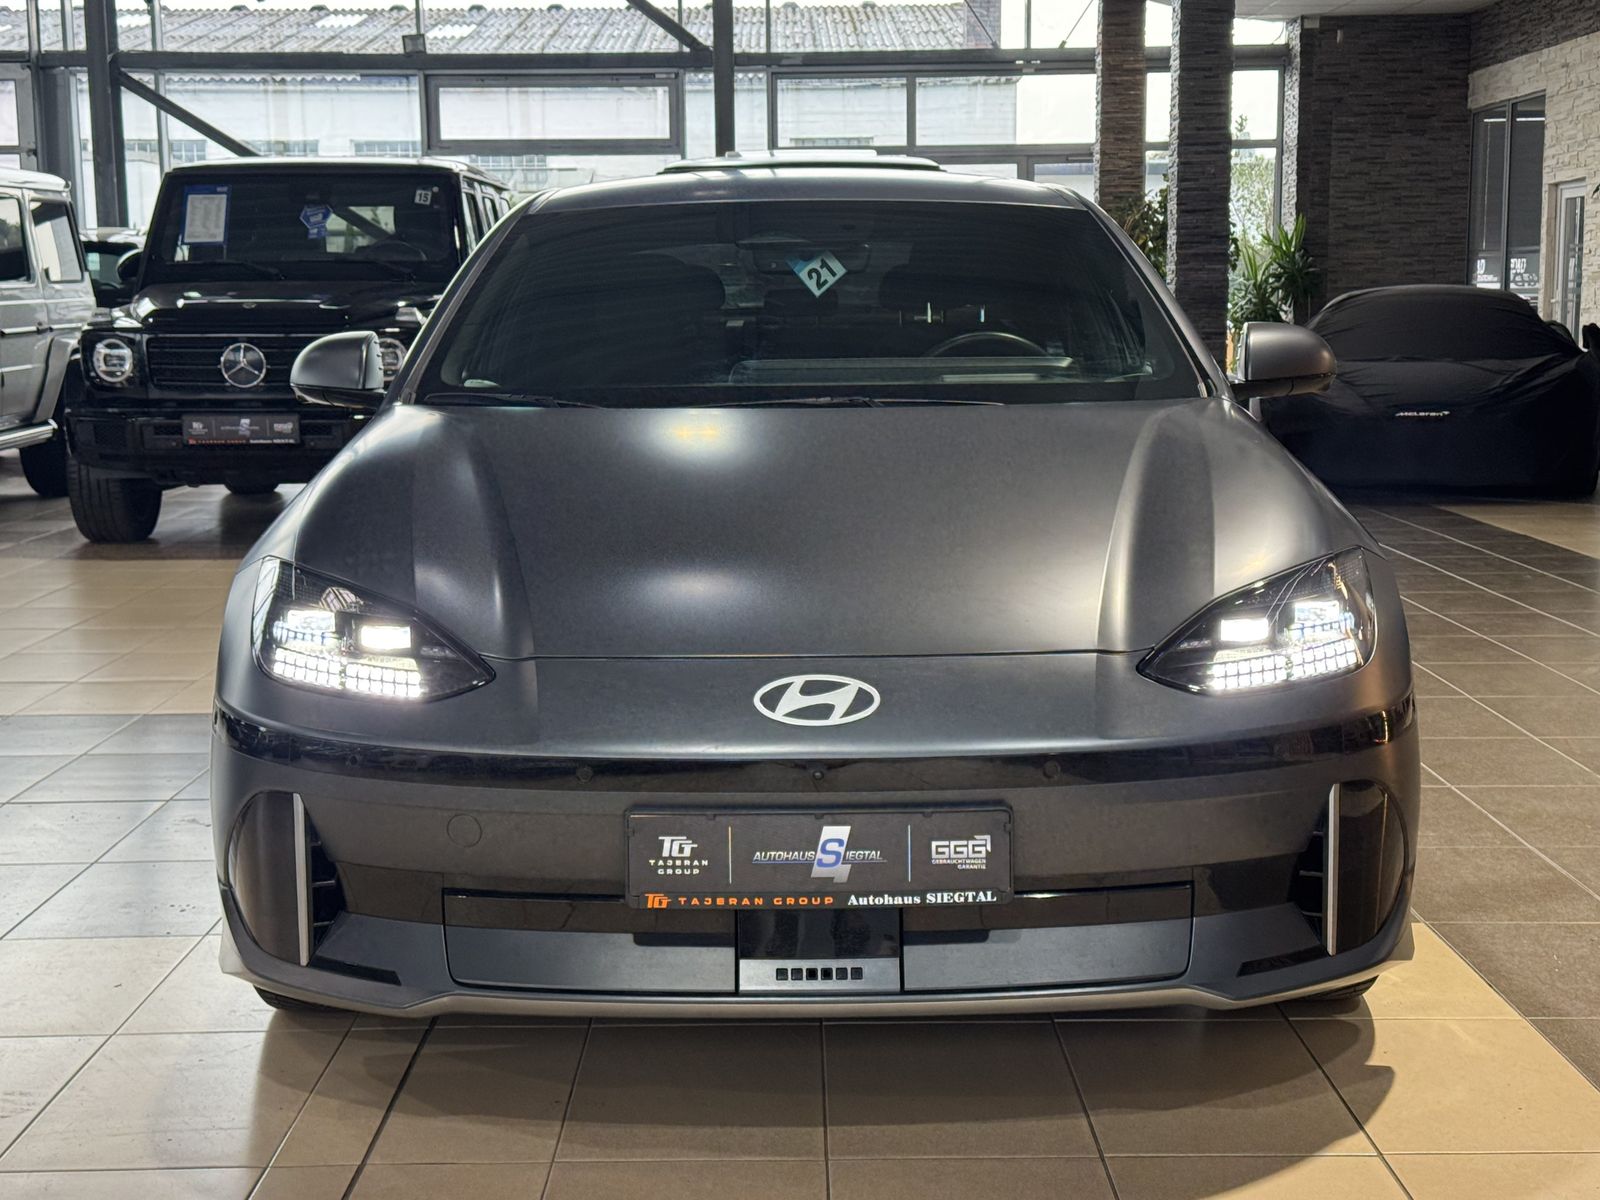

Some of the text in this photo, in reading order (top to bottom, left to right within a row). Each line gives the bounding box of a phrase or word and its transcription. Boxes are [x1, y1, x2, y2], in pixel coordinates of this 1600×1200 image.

[418, 191, 430, 203] 15
[807, 258, 837, 290] 21
[752, 851, 816, 861] AUTOHAUS
[931, 840, 986, 859] GGG
[678, 897, 763, 906] TAJERAN
[773, 896, 834, 905] GROUP
[847, 894, 921, 906] Autohaus
[925, 890, 997, 904] SIEGTAL
